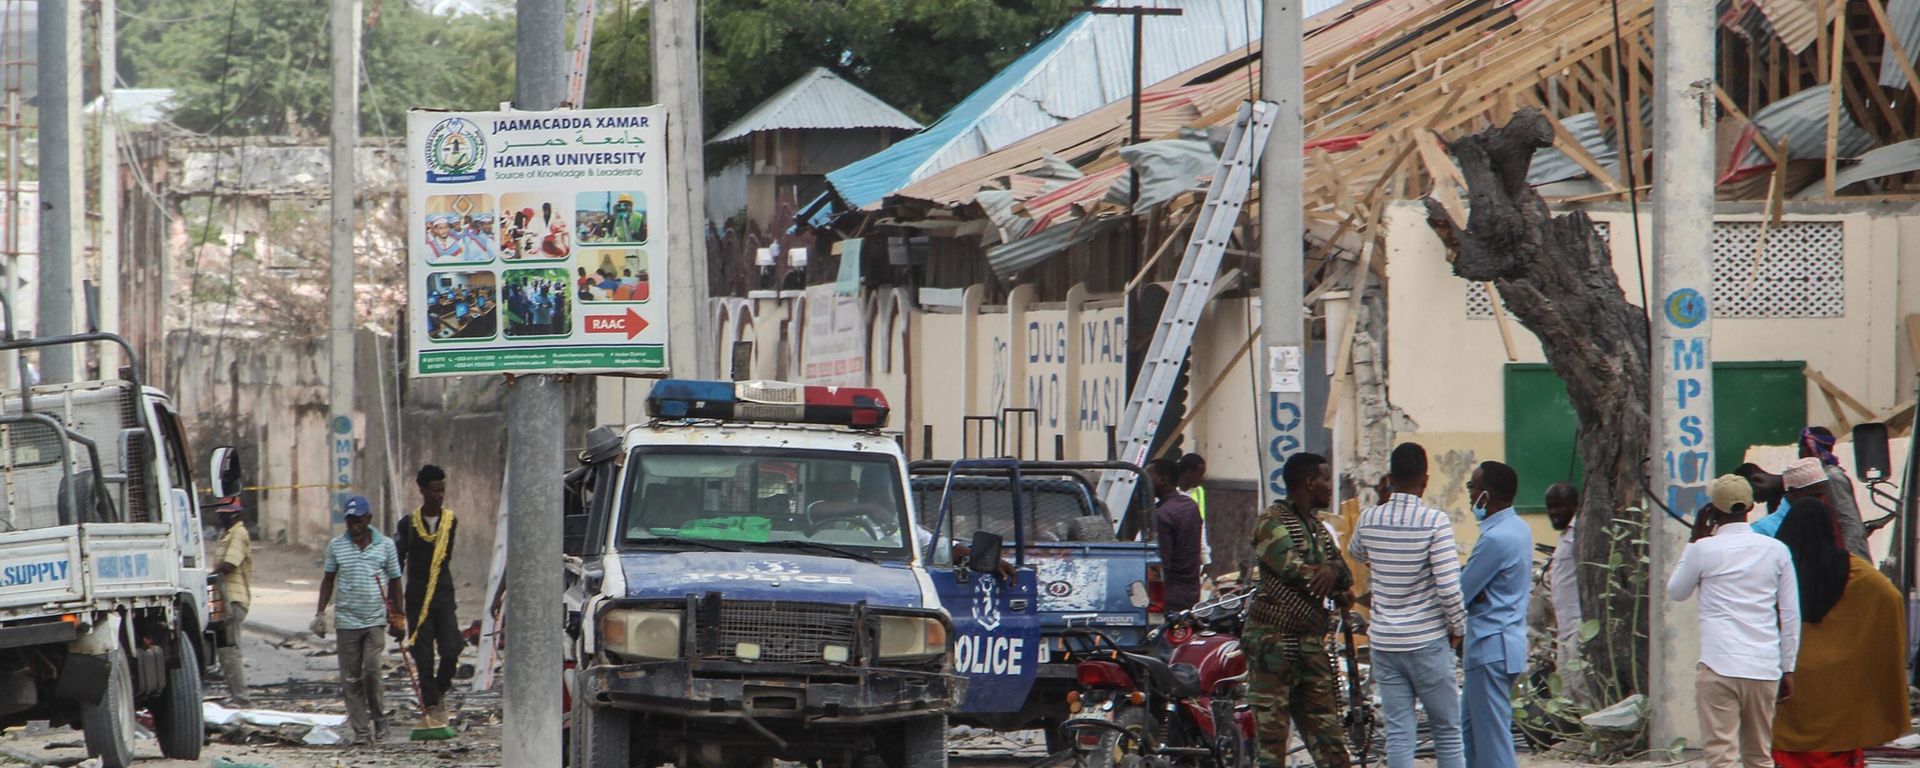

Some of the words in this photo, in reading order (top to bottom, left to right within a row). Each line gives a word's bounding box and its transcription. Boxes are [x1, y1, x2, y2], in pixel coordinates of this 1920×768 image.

[492, 117, 592, 135] JAAMACADDA
[596, 116, 649, 129] XAMAR
[493, 154, 550, 168] HAMAR
[556, 152, 646, 166] UNIVERSITY
[495, 171, 523, 180] Source
[527, 170, 535, 178] of
[597, 168, 643, 177] Leadership
[592, 319, 626, 330] RAAC
[1673, 339, 1704, 447] MPS
[4, 560, 68, 586] SUPPLY
[685, 572, 854, 584] POLICE
[955, 635, 1024, 675] OLICE
